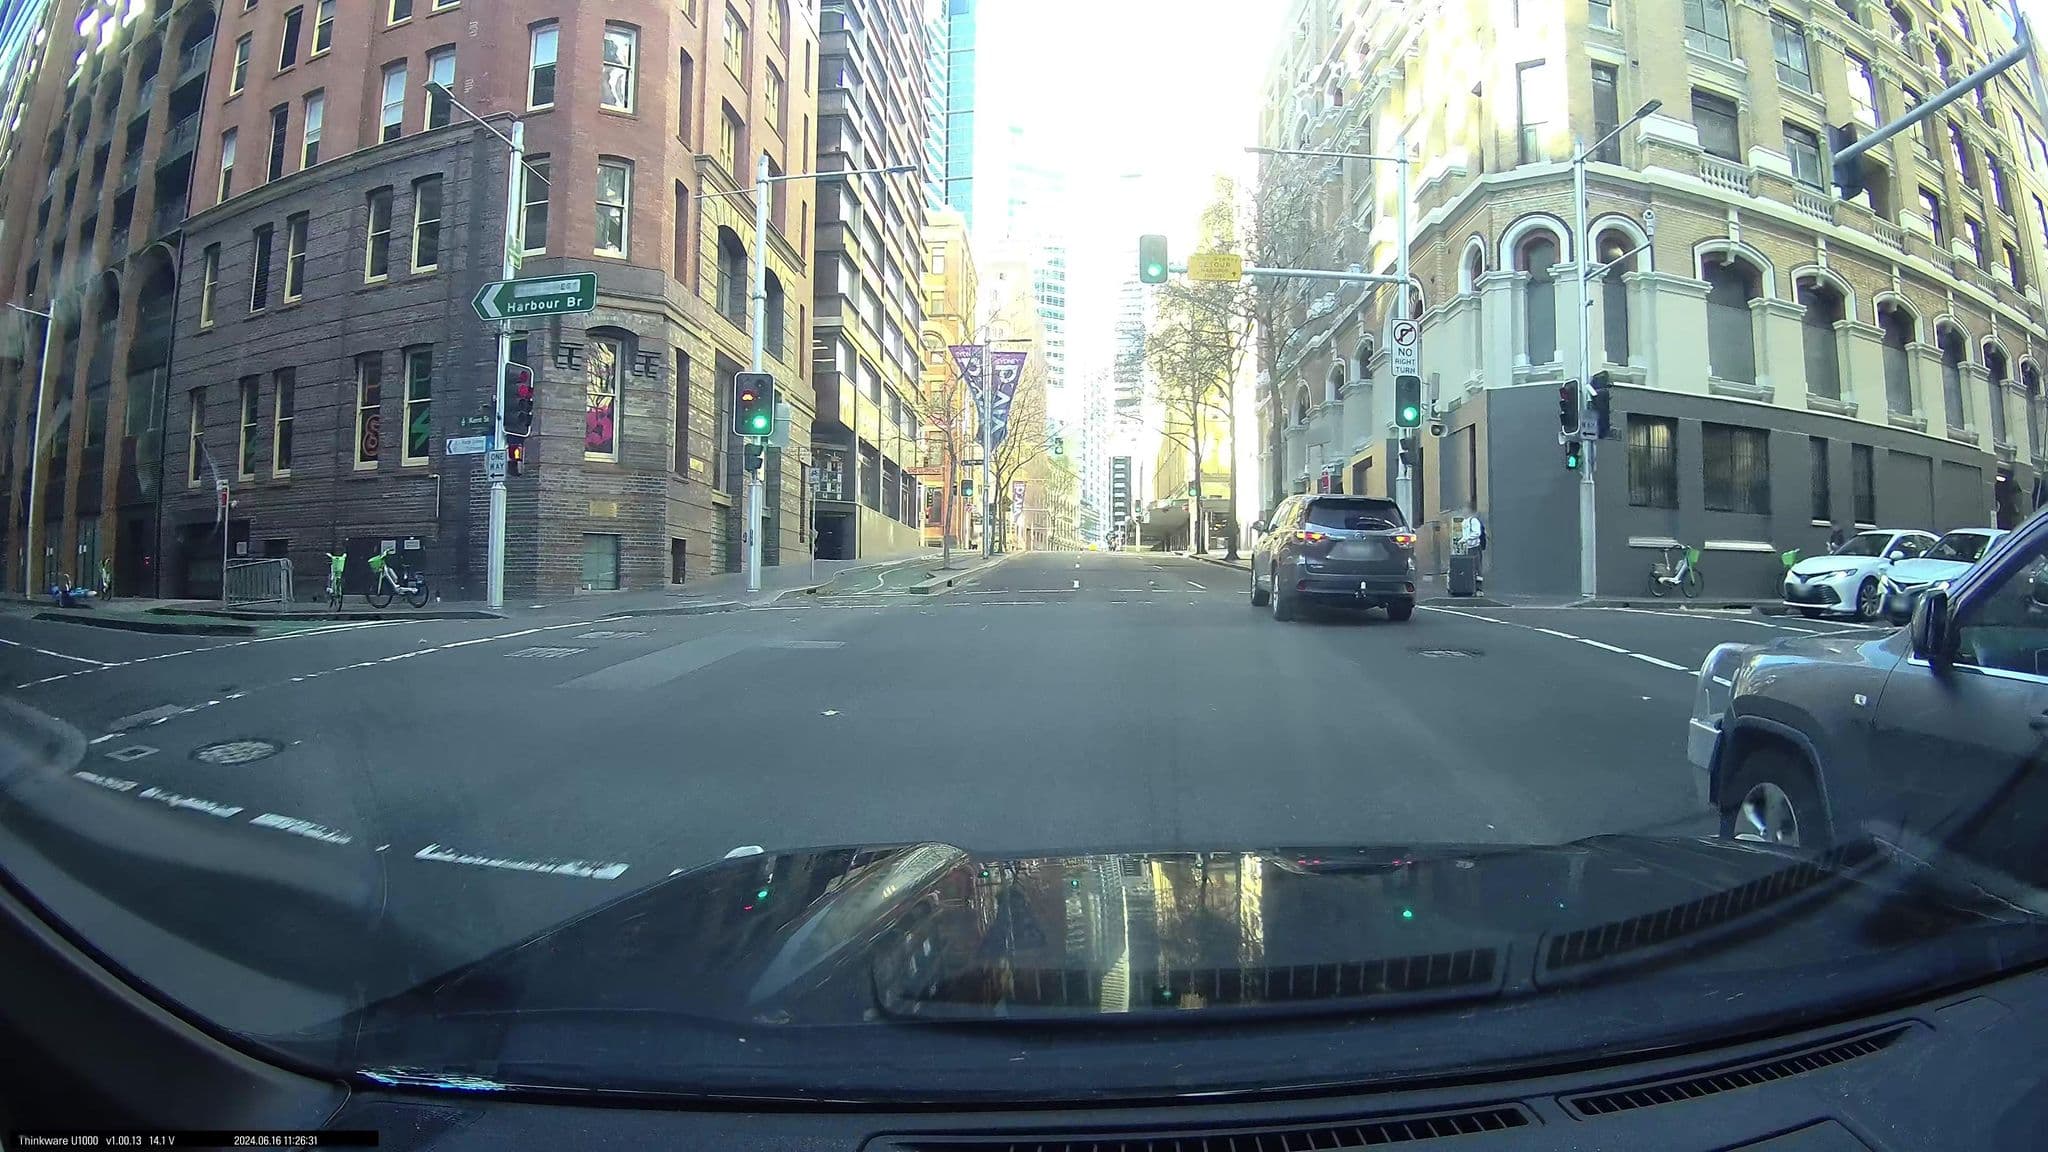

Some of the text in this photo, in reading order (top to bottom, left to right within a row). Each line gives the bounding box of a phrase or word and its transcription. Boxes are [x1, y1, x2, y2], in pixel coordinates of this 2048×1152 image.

[507, 296, 583, 313] Harbour Br
[1398, 347, 1413, 357] NO
[490, 453, 505, 461] ONE
